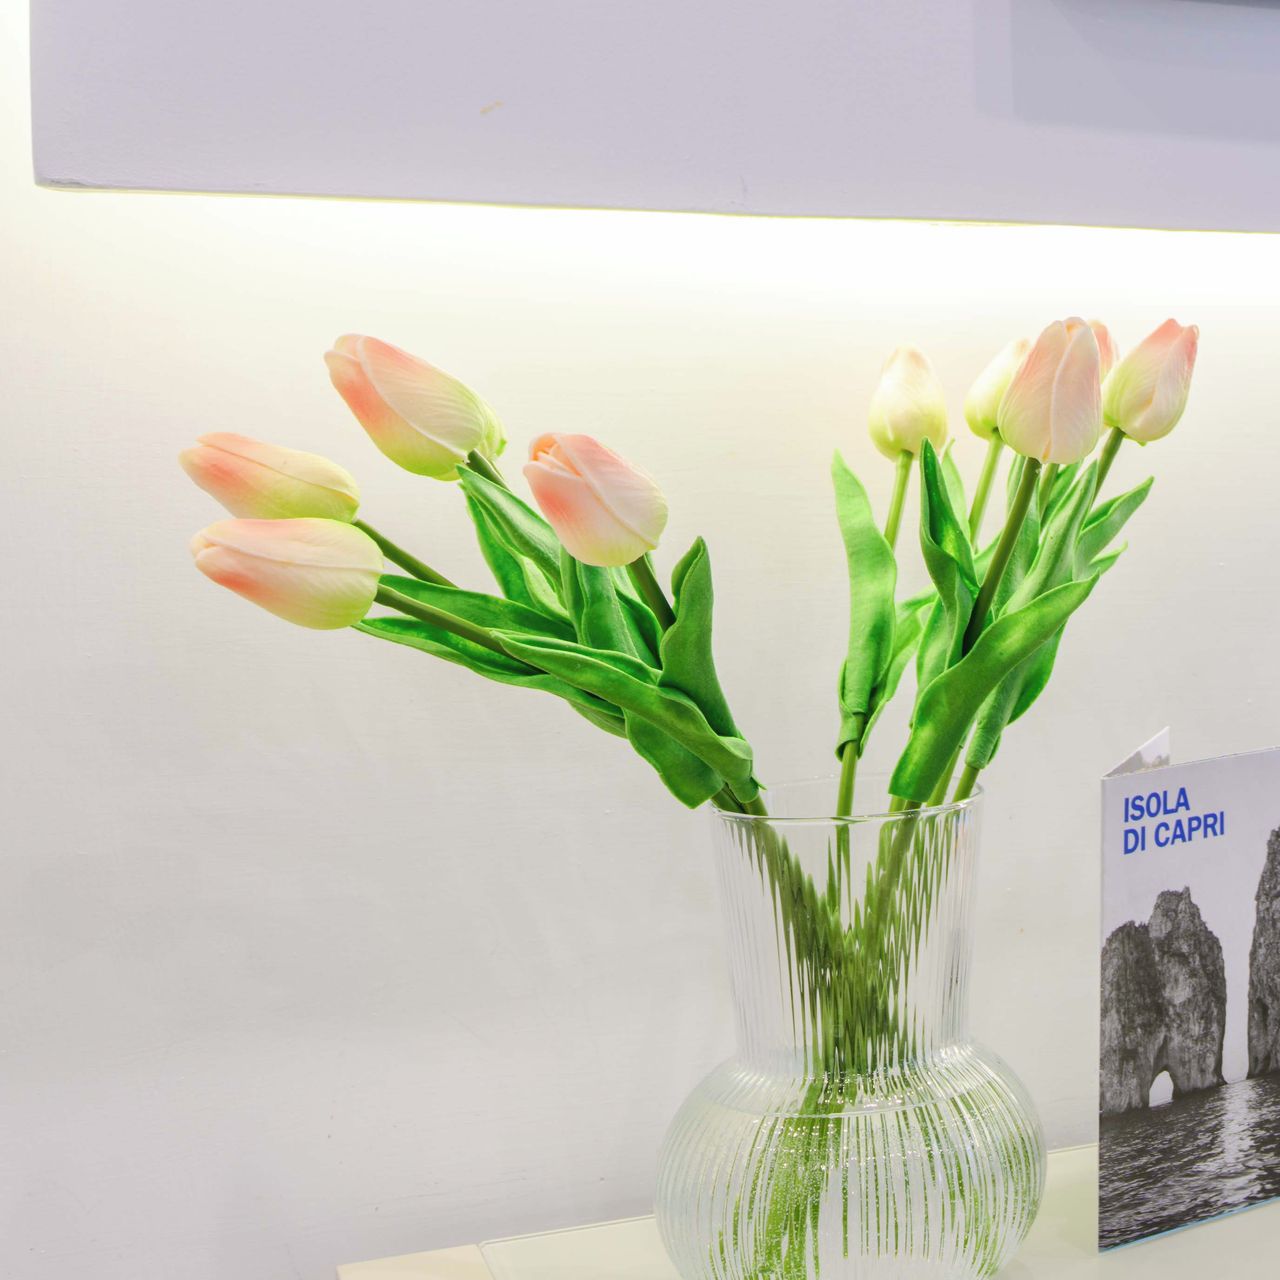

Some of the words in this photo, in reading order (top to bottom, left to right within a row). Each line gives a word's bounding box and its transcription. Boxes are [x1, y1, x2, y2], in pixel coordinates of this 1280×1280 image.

[1124, 787, 1190, 823] ISOLA
[1123, 825, 1146, 855] DI
[1154, 811, 1225, 848] CAPRI
